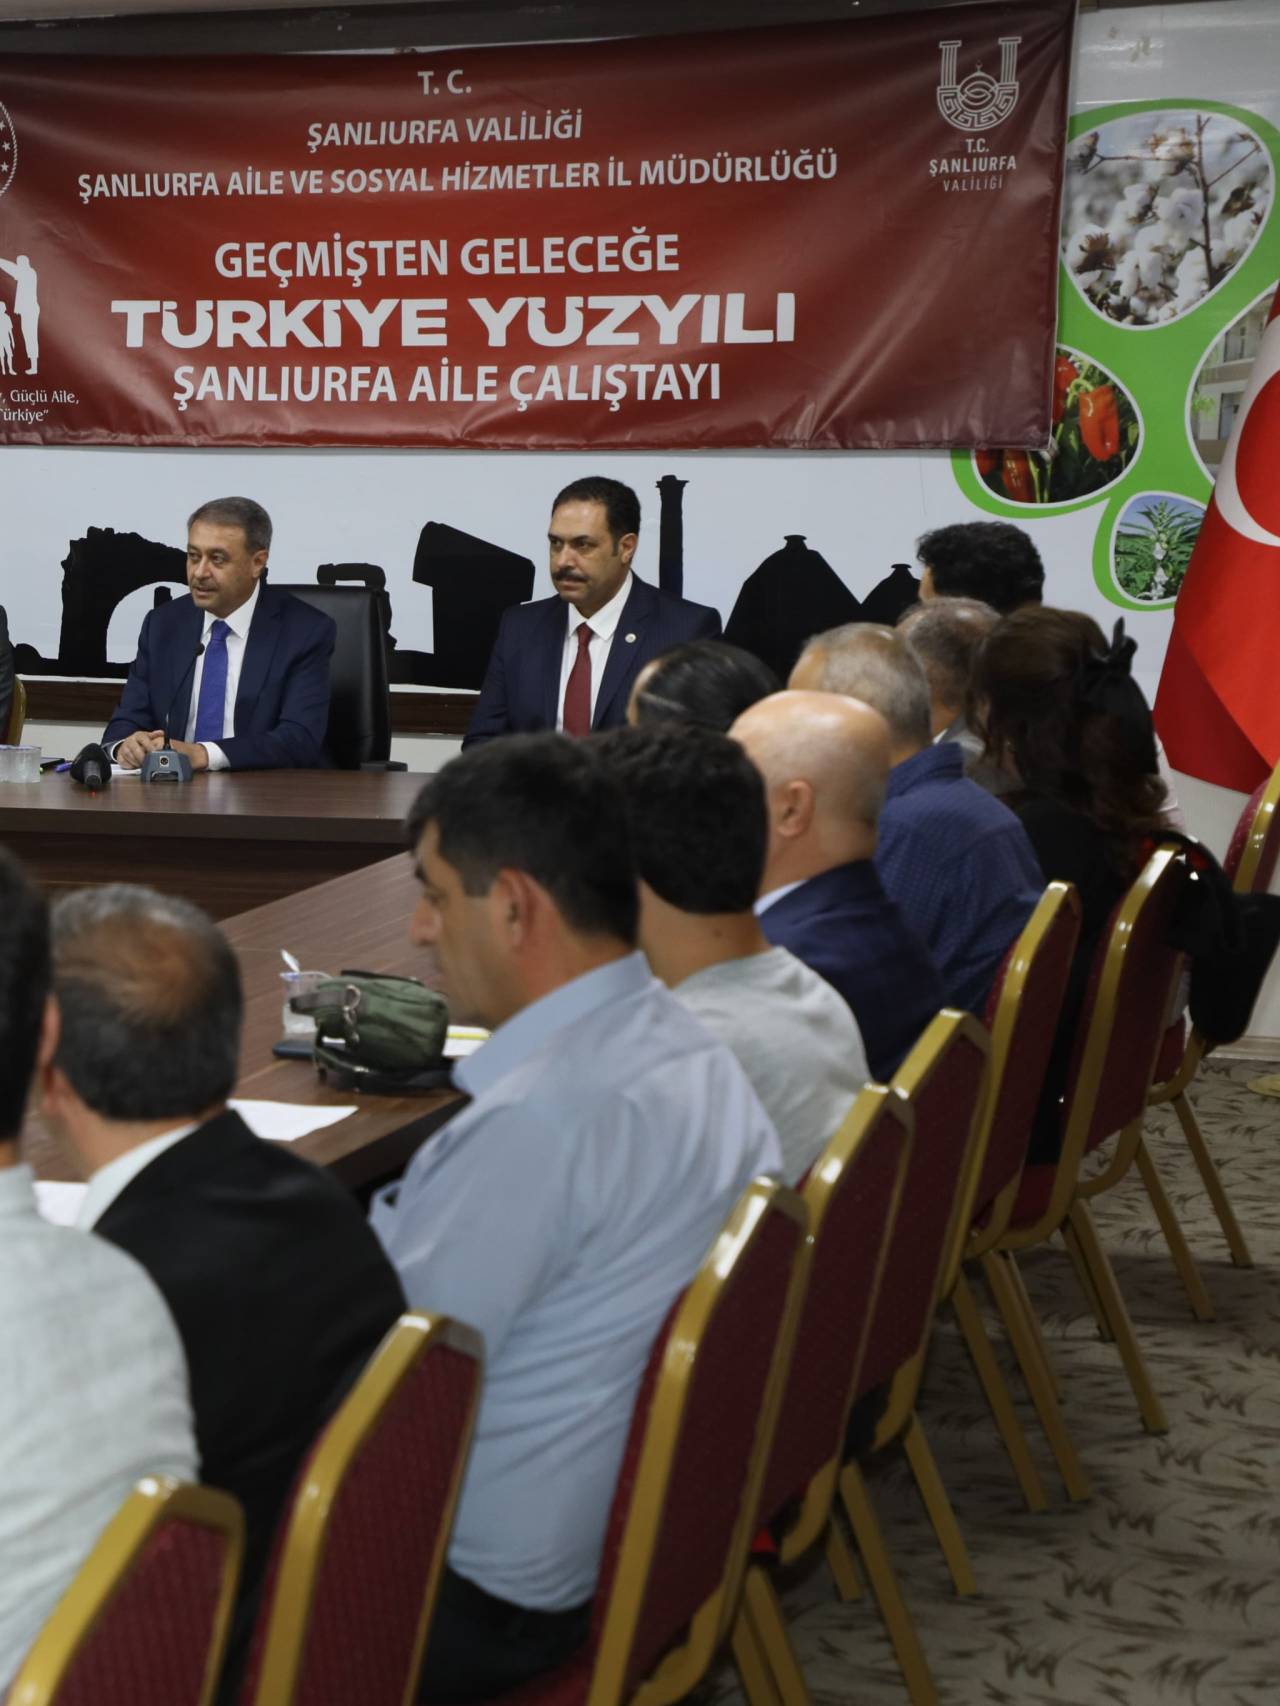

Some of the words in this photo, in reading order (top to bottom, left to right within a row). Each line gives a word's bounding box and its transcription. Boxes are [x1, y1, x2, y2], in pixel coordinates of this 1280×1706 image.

[418, 70, 440, 95] T.
[446, 69, 472, 94] C.
[307, 119, 459, 153] ŞANLIURFA
[466, 108, 583, 142] VALİLİĞİ
[965, 138, 990, 153] T.C.
[78, 173, 220, 204] ŞANLIURFA
[226, 166, 284, 195] AİLE
[289, 170, 323, 194] VE
[330, 168, 434, 193] SOSYAL
[441, 160, 600, 191] HİZMETLER
[607, 155, 632, 186] İL
[639, 147, 838, 185] MÜDÜRLÜĞÜ
[929, 155, 1017, 177] ŞANLIURFA
[943, 174, 1003, 192] VALİLİĞİ
[215, 232, 449, 288] GEÇMİŞTEN
[460, 226, 680, 275] GELECEĞE
[10, 390, 48, 405] Güçlü
[51, 390, 80, 404] Aile,
[173, 365, 397, 411] ŞANLIURFA
[408, 357, 498, 402] AİLE
[509, 362, 721, 412] ÇALIŞTAYI
